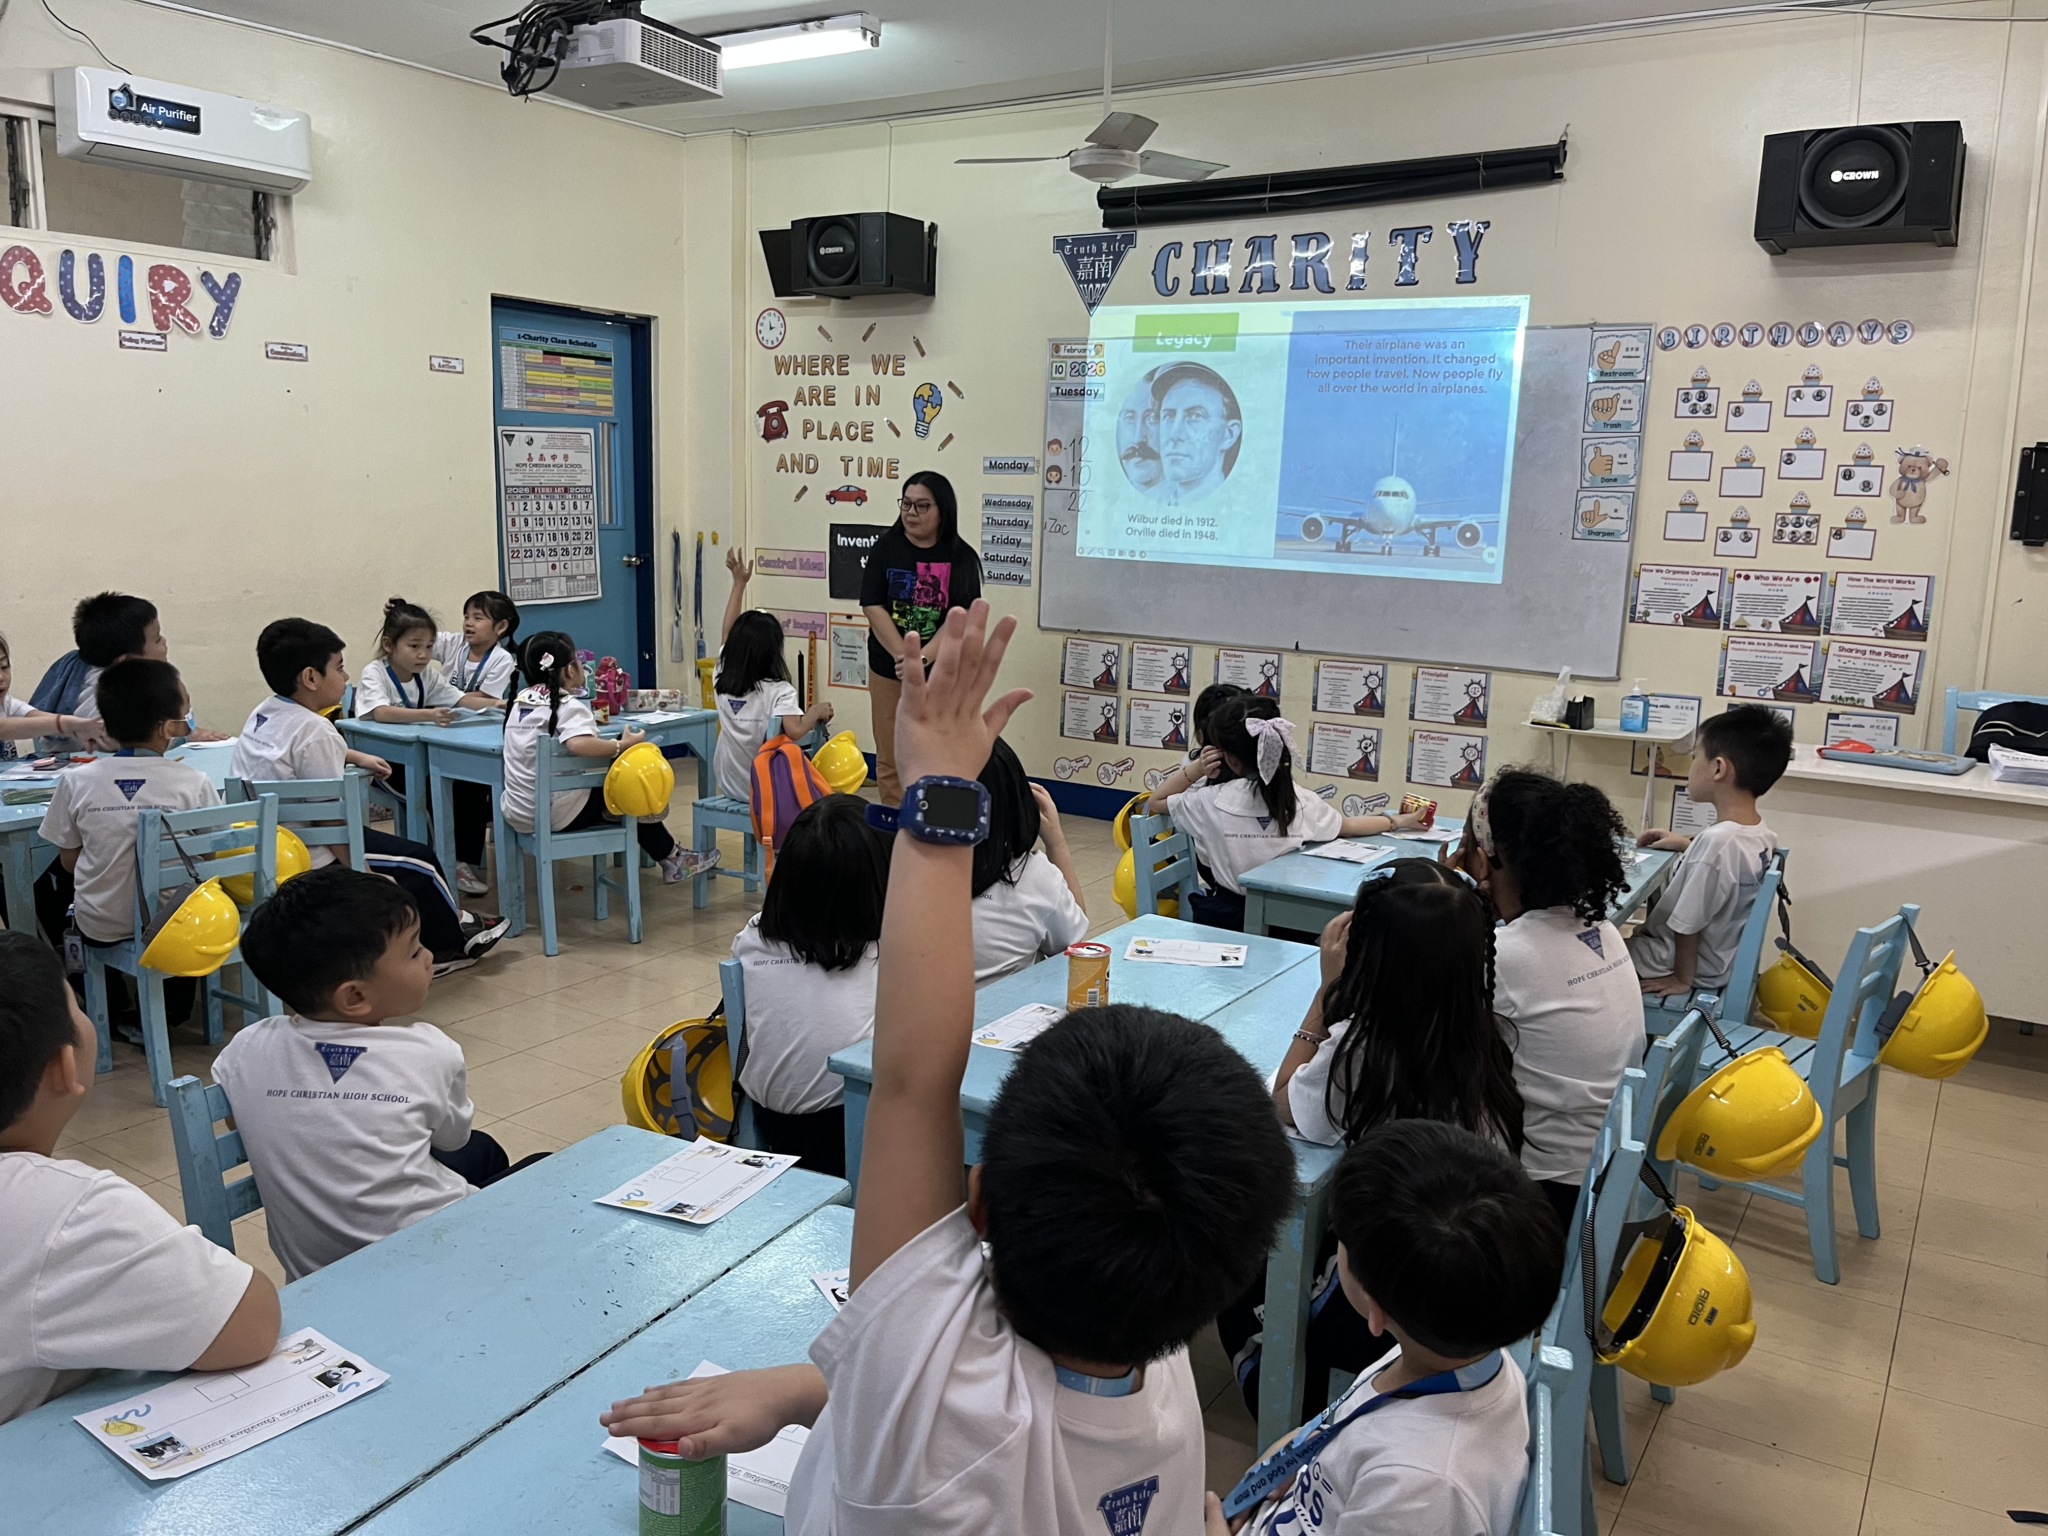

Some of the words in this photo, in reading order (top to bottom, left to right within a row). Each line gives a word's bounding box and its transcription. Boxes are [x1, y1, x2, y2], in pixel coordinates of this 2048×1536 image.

[141, 102, 156, 114] Air
[158, 106, 198, 123] Purifier
[1843, 170, 1879, 181] CROWN
[1064, 244, 1097, 255] Truth
[1101, 242, 1125, 252] Life
[1152, 220, 1490, 297] CHARITY
[1076, 254, 1114, 281] 嘉南
[0, 245, 242, 339] QUIRY
[551, 337, 567, 345] Class
[568, 339, 598, 348] Schedule
[1156, 332, 1212, 349] Legacy
[1662, 322, 1909, 349] BIRTHDAYS
[1063, 346, 1093, 355] February
[1345, 340, 1373, 350] Their
[1376, 340, 1421, 352] airplane
[1424, 341, 1448, 349] was
[1450, 341, 1465, 349] an
[774, 354, 850, 375] WHERE
[871, 354, 906, 376] WE
[1315, 354, 1370, 367] important
[1373, 354, 1429, 364] invention.
[1432, 354, 1442, 364] It
[1444, 353, 1496, 367] changed
[1054, 363, 1064, 375] 10
[1070, 361, 1106, 377] 2026
[1306, 369, 1330, 379] how
[1333, 369, 1371, 381] people
[1374, 369, 1409, 379] travel.
[1412, 369, 1440, 379] Now
[1443, 369, 1485, 382] people
[1488, 368, 1503, 382] fly
[1600, 370, 1634, 378] Restroom
[793, 385, 836, 406] ARE
[855, 385, 880, 406] IN
[1055, 387, 1100, 399] Tuesday
[1317, 383, 1330, 393] all
[1333, 384, 1357, 393] over
[1360, 383, 1379, 393] the
[1382, 383, 1414, 394] world
[1417, 384, 1428, 394] in
[1431, 383, 1488, 396] airplanes.
[802, 419, 874, 442] PLACE
[776, 454, 819, 474] AND
[840, 456, 900, 479] TIME
[989, 460, 1029, 472] Monday
[984, 498, 1032, 510] Wednesday
[511, 517, 516, 527] 8
[523, 517, 529, 527] 9
[534, 517, 543, 526] 10
[547, 517, 556, 526] 11
[559, 516, 568, 526] 12
[571, 516, 580, 525] 13
[583, 516, 592, 525] 14
[985, 517, 1030, 529] Thursday
[1128, 513, 1159, 525] Wilbur
[1161, 514, 1183, 526] died
[1185, 515, 1194, 526] in
[1196, 516, 1218, 527] 1912.
[510, 533, 519, 543] 15
[522, 533, 532, 542] 16
[535, 533, 544, 542] 17
[547, 532, 557, 541] 18
[560, 532, 569, 541] 19
[572, 532, 581, 541] 20
[584, 531, 593, 540] 21
[1125, 527, 1157, 538] Orville
[1159, 528, 1180, 539] died
[1182, 529, 1191, 539] in
[1194, 530, 1218, 541] 1948.
[1587, 529, 1615, 538] Sharpen
[991, 535, 1022, 547] Friday
[511, 549, 520, 559] 22
[523, 549, 533, 558] 23
[536, 549, 545, 558] 24
[548, 548, 558, 557] 25
[561, 548, 570, 557] 26
[572, 547, 581, 556] 27
[584, 546, 593, 555] 28
[983, 552, 1029, 565] Saturday
[757, 556, 798, 571] Central
[799, 558, 824, 572] Idea
[987, 571, 1024, 583] Sunday
[781, 618, 791, 627] of
[793, 619, 825, 633] Inquiry
[1838, 645, 1867, 656] Sharing
[1884, 651, 1909, 660] Planet
[1421, 670, 1449, 678] Principled
[1418, 733, 1449, 743] Reflective
[1567, 974, 1586, 987] HOPE
[1587, 964, 1613, 980] CHRISTIAN
[266, 1089, 288, 1097] HOPE
[290, 1090, 340, 1099] CHRISTIAN
[343, 1092, 368, 1100] HIGH
[370, 1093, 411, 1103] SCHOOL
[1267, 1465, 1286, 1483] God
[1250, 1479, 1266, 1496] and
